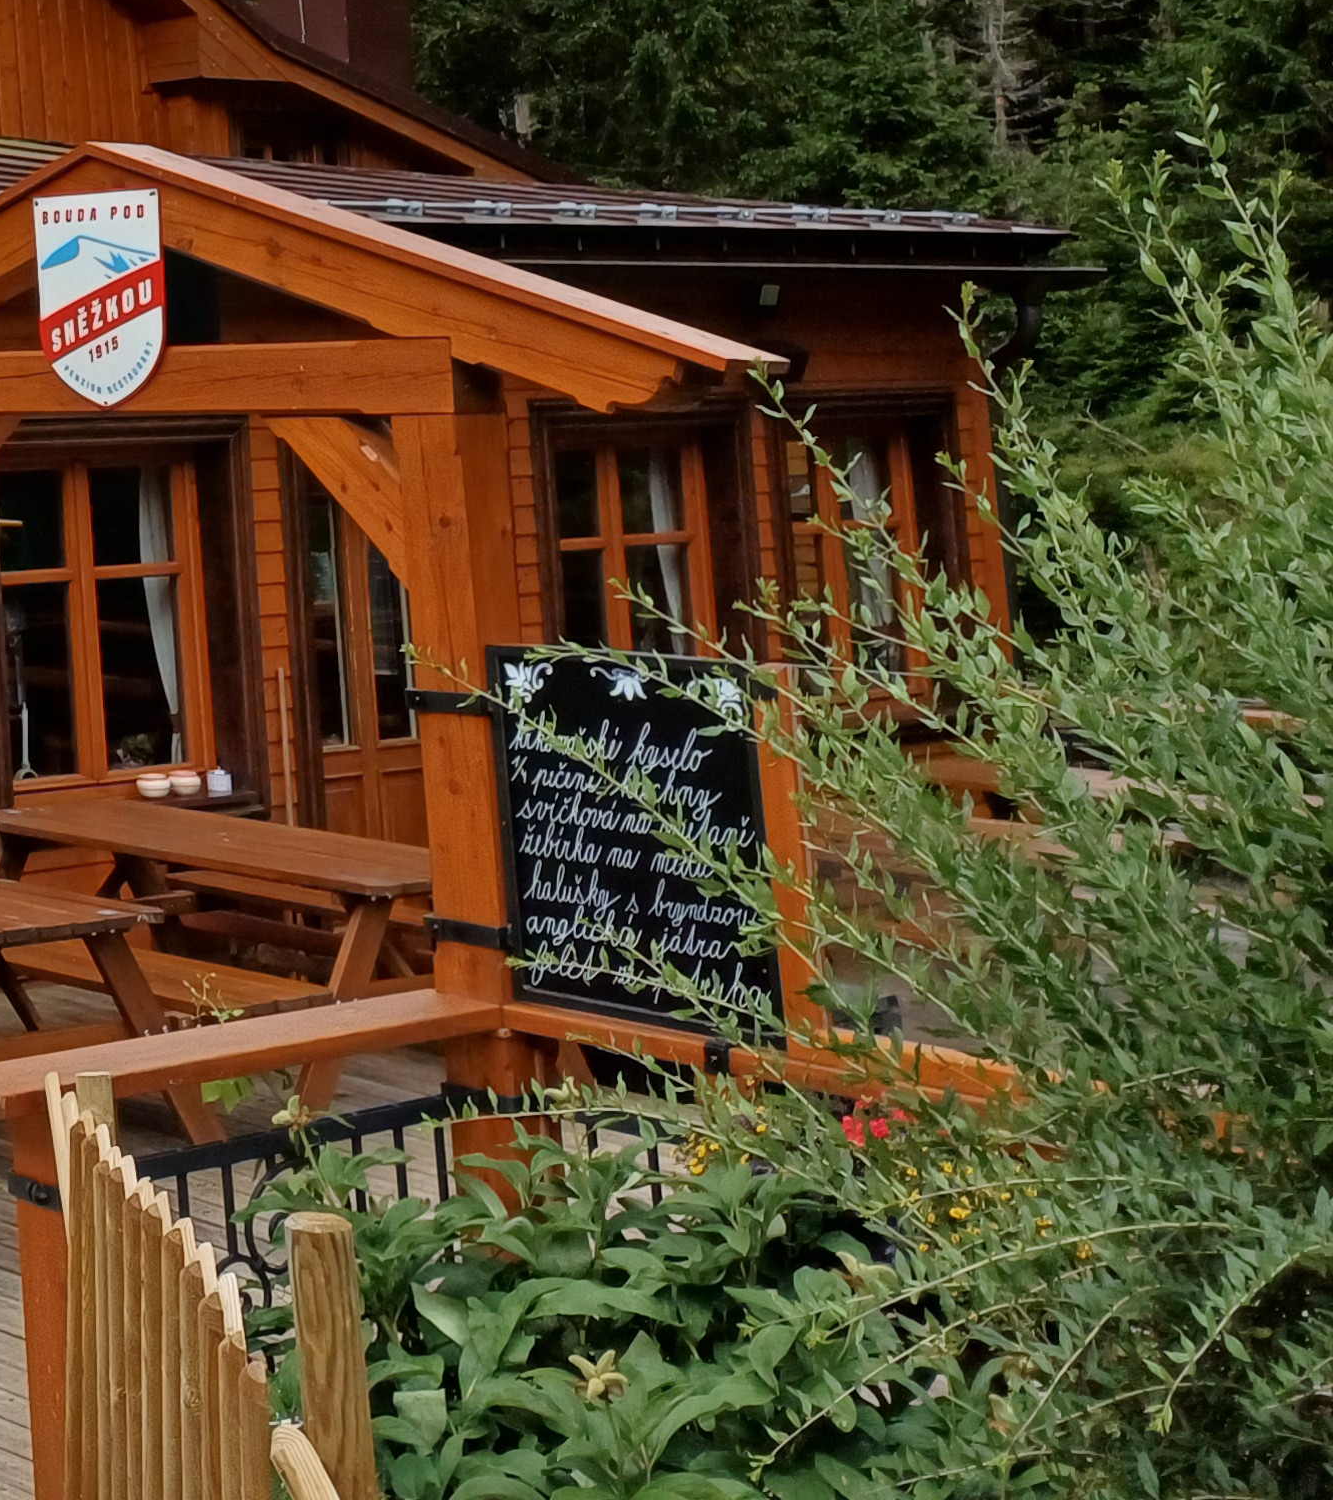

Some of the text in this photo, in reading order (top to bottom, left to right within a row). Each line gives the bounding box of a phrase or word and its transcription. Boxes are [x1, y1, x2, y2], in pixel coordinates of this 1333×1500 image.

[42, 204, 144, 225] BOUDA POD
[51, 278, 153, 353] SNĚŽKOU
[64, 340, 153, 394] PENZION RESTAURANT
[89, 336, 119, 362] 1915
[625, 722, 713, 775] kyselo
[515, 791, 621, 830] svíčková
[518, 820, 603, 864] žebírka
[606, 847, 641, 869] na
[523, 859, 621, 921] halušky
[624, 892, 640, 914] s
[656, 924, 734, 961] játra
